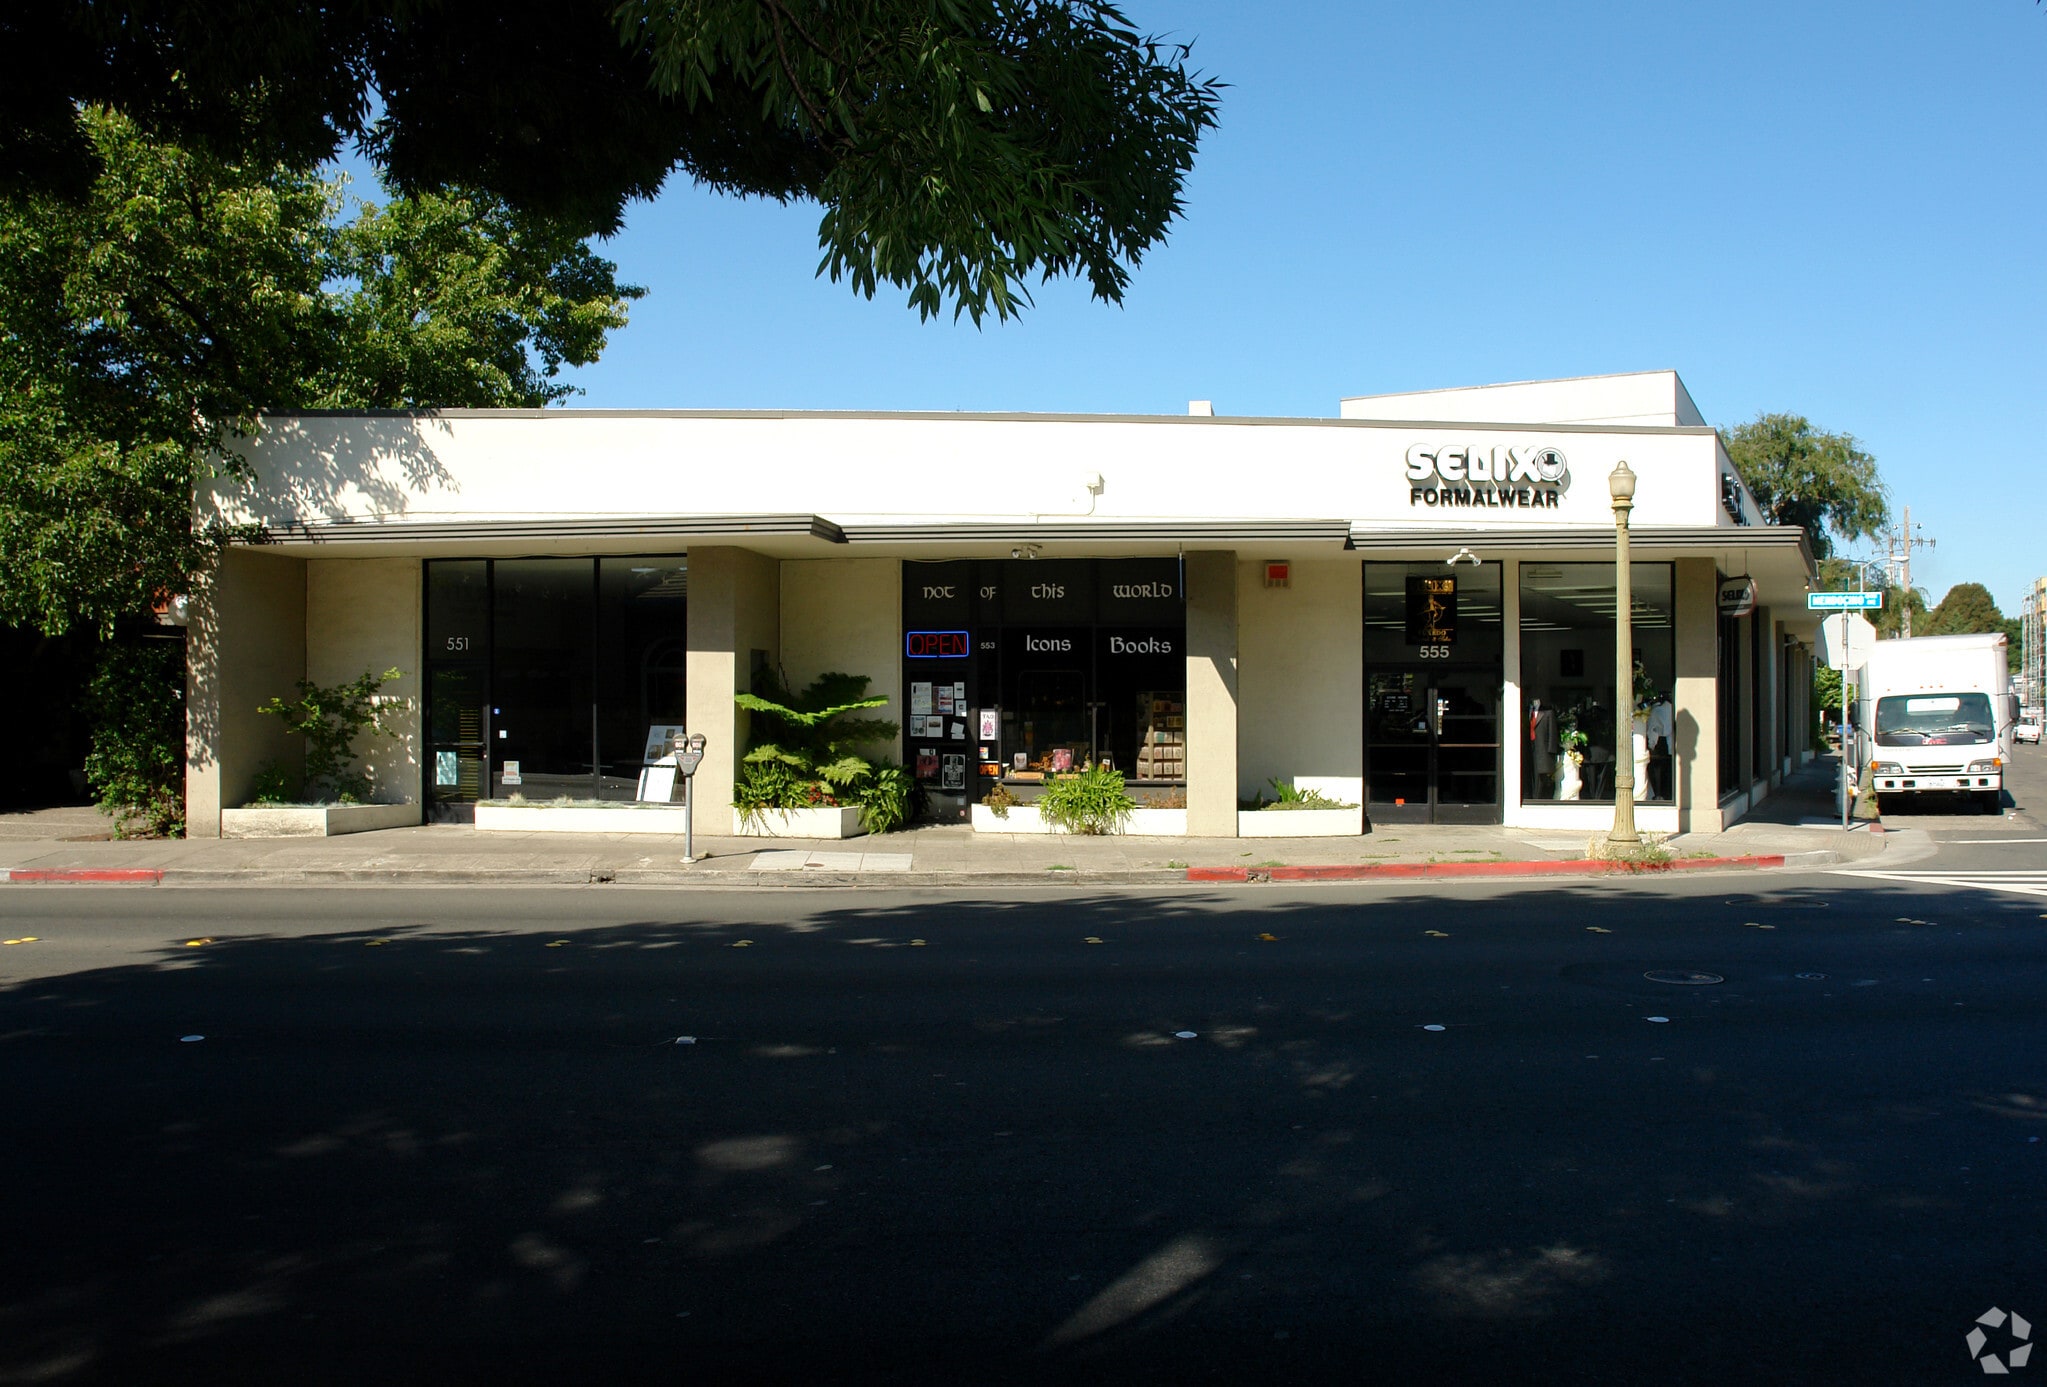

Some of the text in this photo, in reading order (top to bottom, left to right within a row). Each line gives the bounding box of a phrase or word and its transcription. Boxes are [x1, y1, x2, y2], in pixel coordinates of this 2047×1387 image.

[1406, 443, 1542, 482] SELIX
[1410, 487, 1559, 508] FORMALWEAR
[446, 637, 469, 651] 551
[909, 634, 967, 655] OPEN
[980, 642, 996, 650] 553
[1026, 635, 1172, 654] Icons Books
[1419, 645, 1450, 659] 555
[979, 764, 999, 776] OPEN
